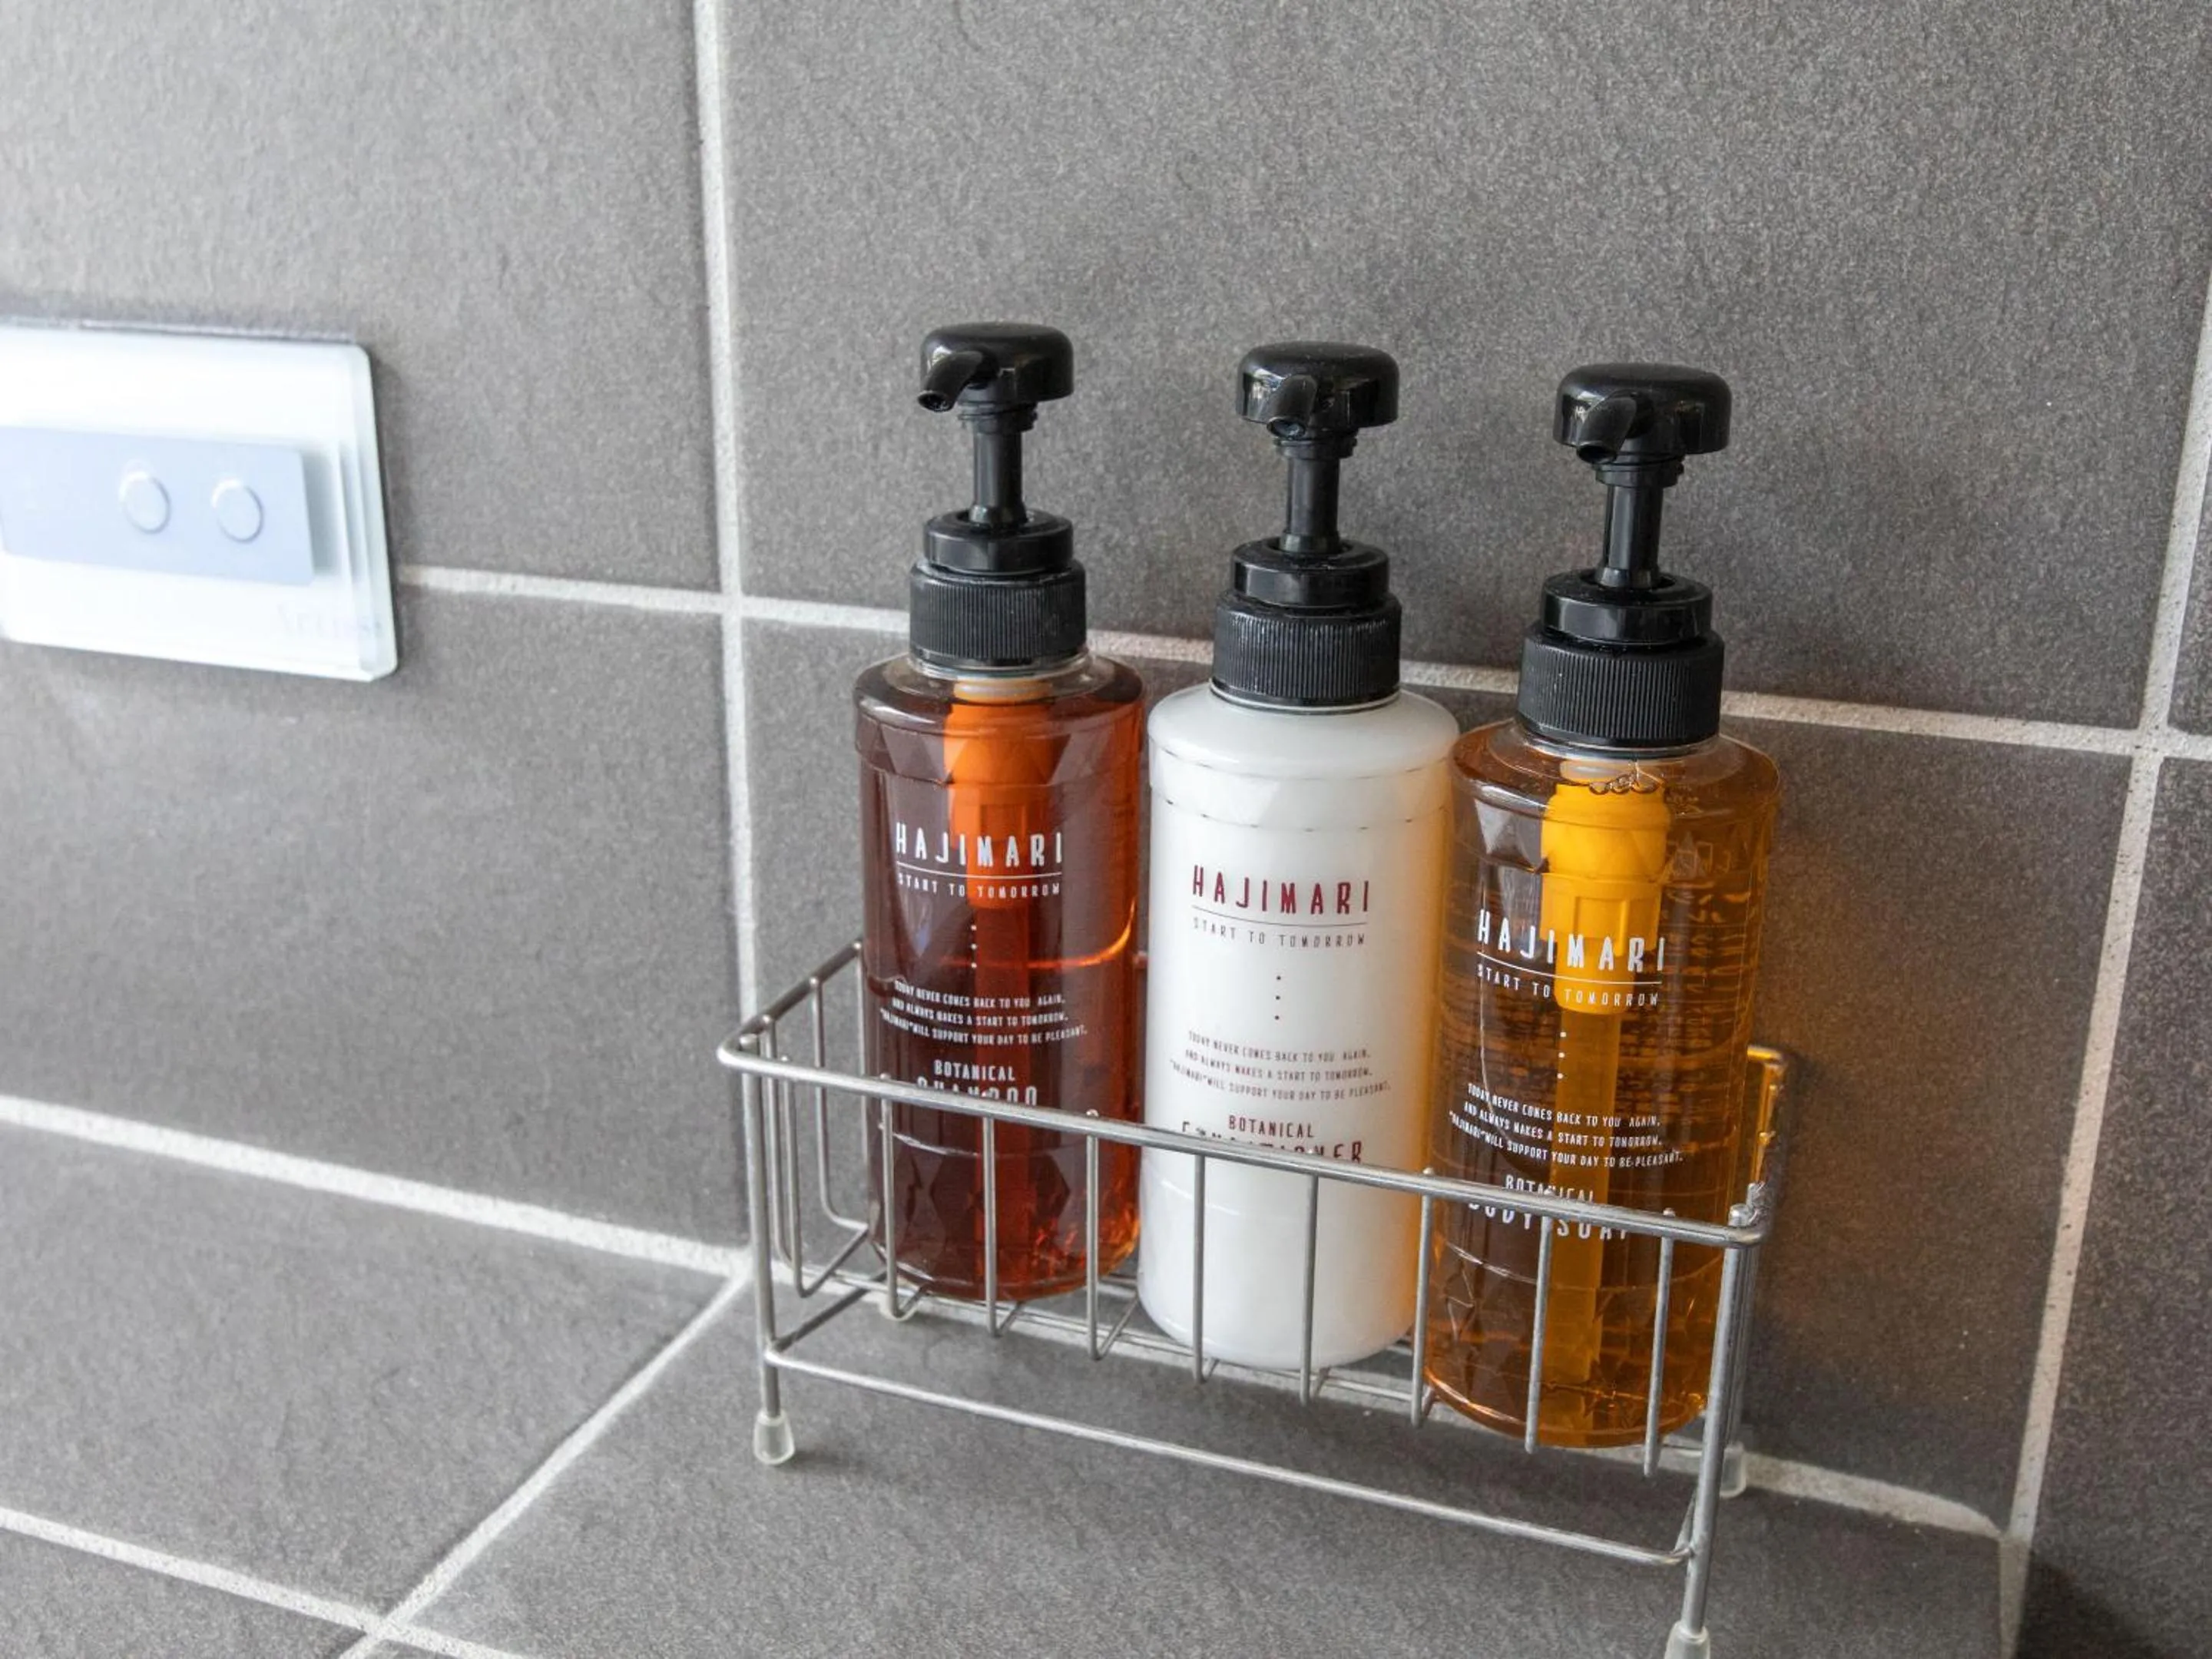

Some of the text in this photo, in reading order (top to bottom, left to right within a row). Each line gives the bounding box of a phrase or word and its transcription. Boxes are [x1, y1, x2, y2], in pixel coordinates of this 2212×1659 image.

[896, 822, 1062, 867] HAJIMARI
[897, 873, 1060, 899] START TO TOMORROW
[1192, 864, 1369, 915] HAJIMARI
[1193, 917, 1365, 948] START TO TOMORROW
[1478, 909, 1665, 972] HAJIMARI
[1478, 964, 1658, 1007] START TO TOMORROW
[1000, 997, 1011, 1008] TO
[1014, 997, 1030, 1008] YOU
[966, 1015, 973, 1025] A
[975, 1015, 1003, 1026] START
[1007, 1015, 1018, 1026] TO
[997, 1034, 1014, 1045] DAY
[1018, 1033, 1028, 1045] TO
[934, 1059, 1015, 1081] BOTANICAL
[1303, 1051, 1313, 1063] TO
[1277, 1070, 1305, 1081] START
[1310, 1071, 1320, 1081] TO
[1321, 1091, 1331, 1101] TO
[1492, 1094, 1519, 1112] NEVER
[1522, 1104, 1552, 1121] COMES
[1557, 1111, 1581, 1124] BACK
[1586, 1115, 1598, 1127] TO
[1603, 1116, 1621, 1128] YOU
[1629, 1114, 1660, 1128] AGAIN.
[1229, 1115, 1315, 1138] BOTANICAL
[1479, 1109, 1511, 1131] ALWAYS
[1513, 1121, 1544, 1140] MAKES
[1547, 1130, 1553, 1141] A
[1558, 1131, 1588, 1146] START
[1593, 1136, 1604, 1147] TO
[1506, 1139, 1548, 1161] SUPPORT
[1551, 1151, 1575, 1165] YOUR
[1580, 1154, 1599, 1167] DAY
[1604, 1157, 1615, 1167] TO
[1634, 1148, 1684, 1167] PLEASANT.
